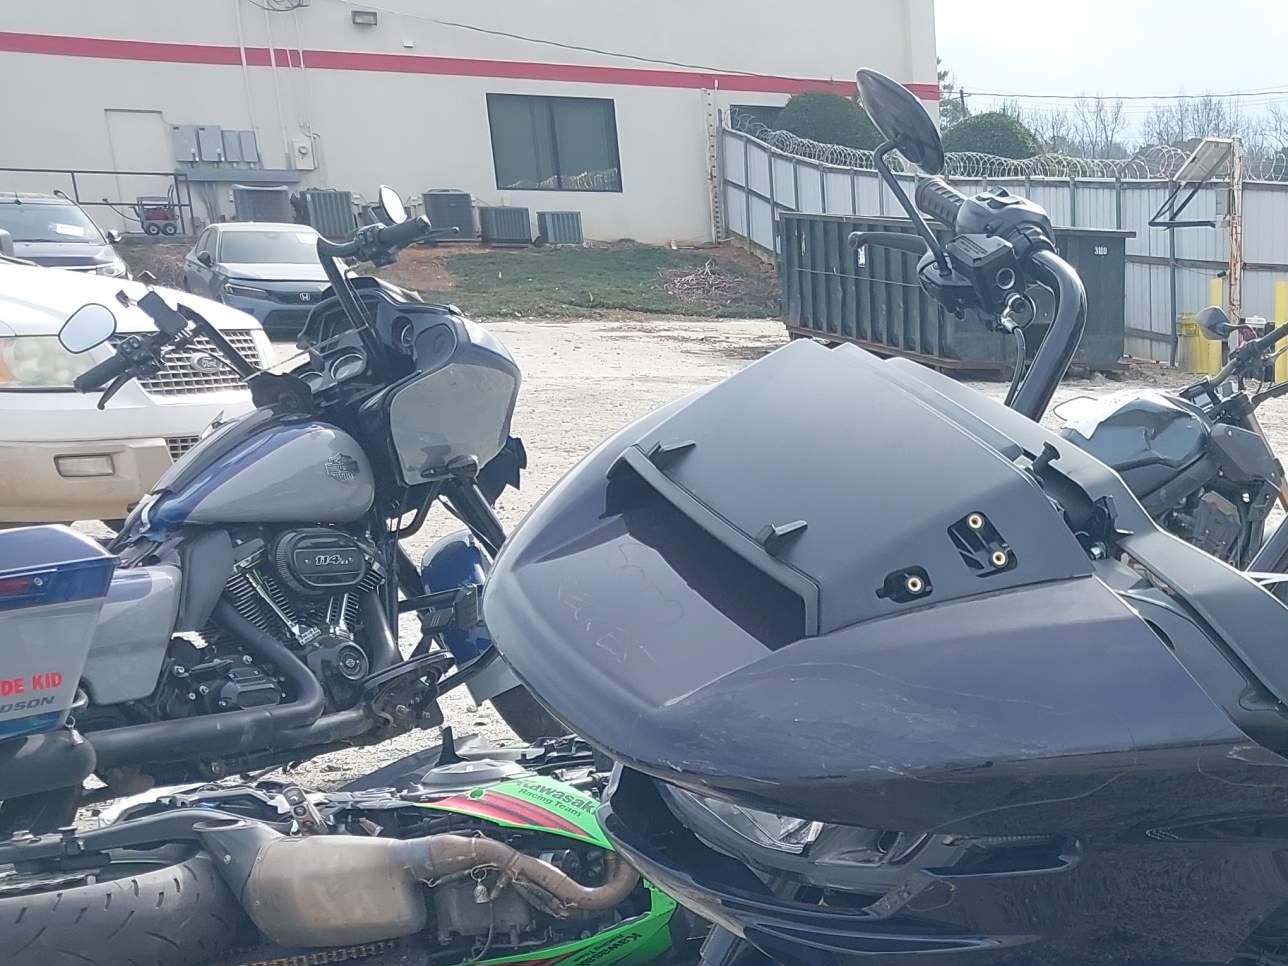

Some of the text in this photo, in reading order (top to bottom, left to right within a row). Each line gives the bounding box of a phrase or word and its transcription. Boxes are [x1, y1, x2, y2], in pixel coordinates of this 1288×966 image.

[32, 672, 63, 691] KID
[518, 787, 581, 817] Racing Team
